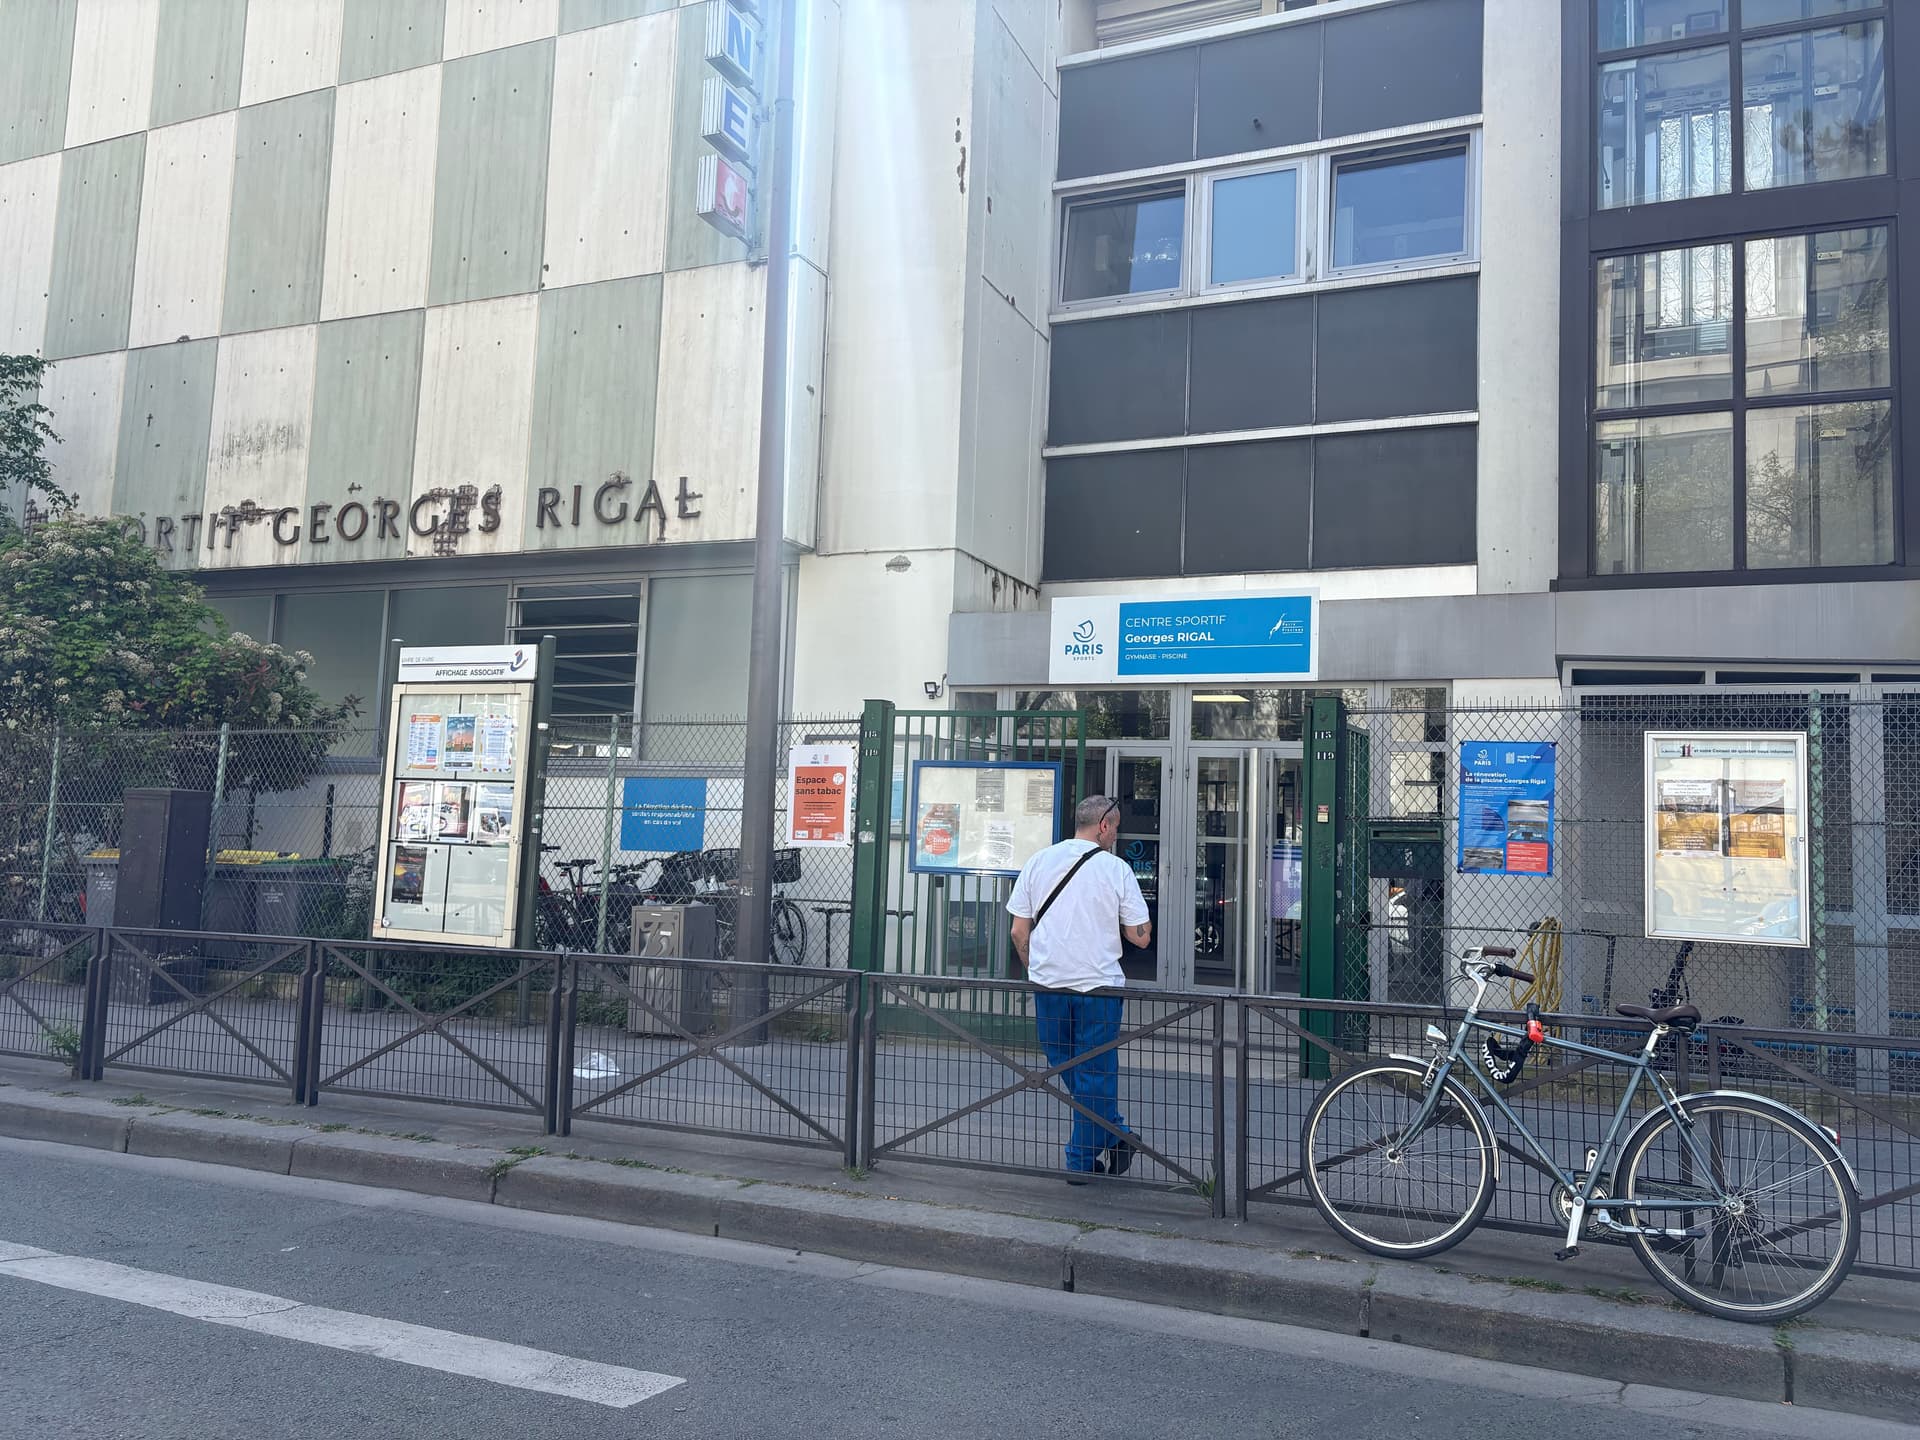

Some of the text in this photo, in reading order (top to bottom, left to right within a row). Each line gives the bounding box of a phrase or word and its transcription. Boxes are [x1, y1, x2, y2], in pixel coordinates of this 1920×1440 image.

[272, 487, 502, 546] GEORGES
[536, 475, 704, 530] RIGAL
[1125, 614, 1227, 628] CENTRE SPORTIF
[1125, 631, 1215, 645] Georges RIGAL
[1065, 643, 1104, 656] PARIS
[1161, 652, 1188, 660] PISCINE
[435, 668, 505, 677] AFFICHAGE ASSOCIATIF
[1314, 731, 1332, 739] 115
[1316, 751, 1335, 760] 119
[796, 776, 827, 785] Espace
[817, 787, 842, 795] tabac
